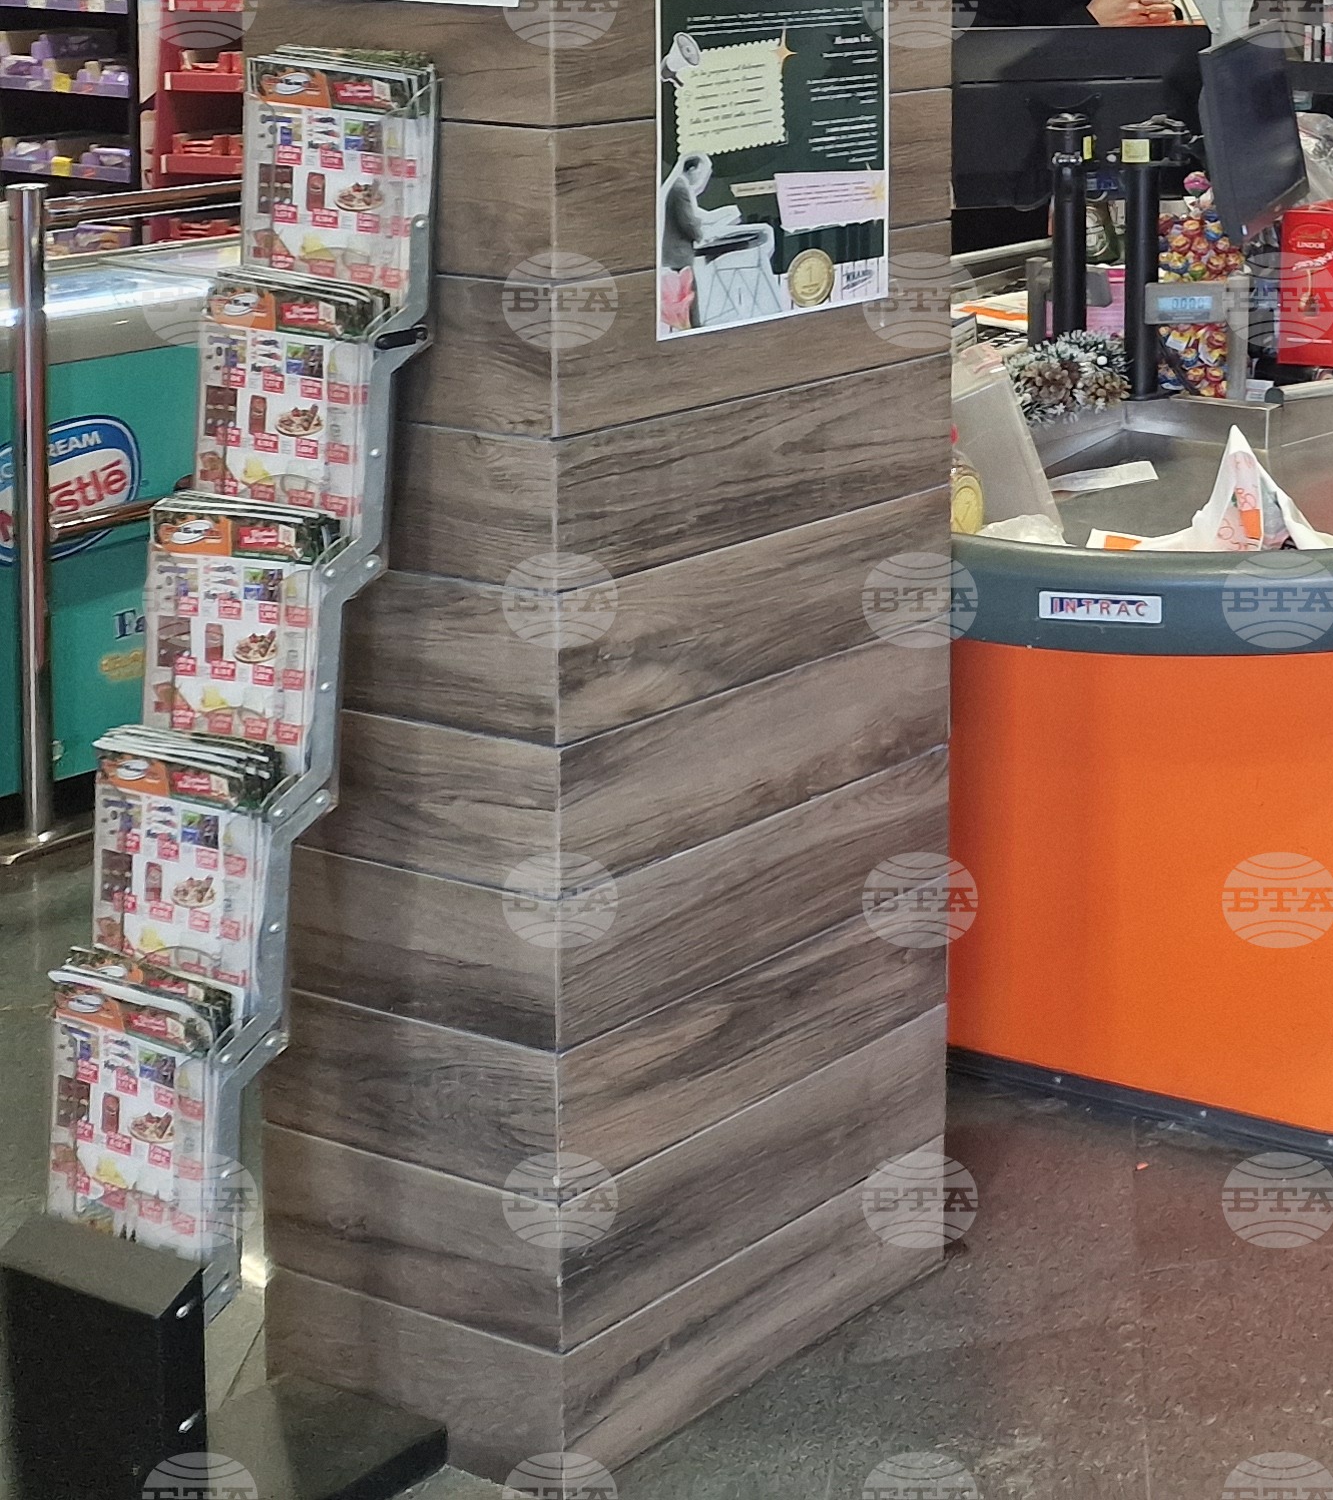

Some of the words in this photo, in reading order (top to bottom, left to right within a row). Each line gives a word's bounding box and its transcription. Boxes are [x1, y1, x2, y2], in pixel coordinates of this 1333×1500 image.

[1296, 241, 1326, 250] LINDOR
[47, 430, 102, 458] REAM
[1051, 596, 1149, 618] INTRAC
